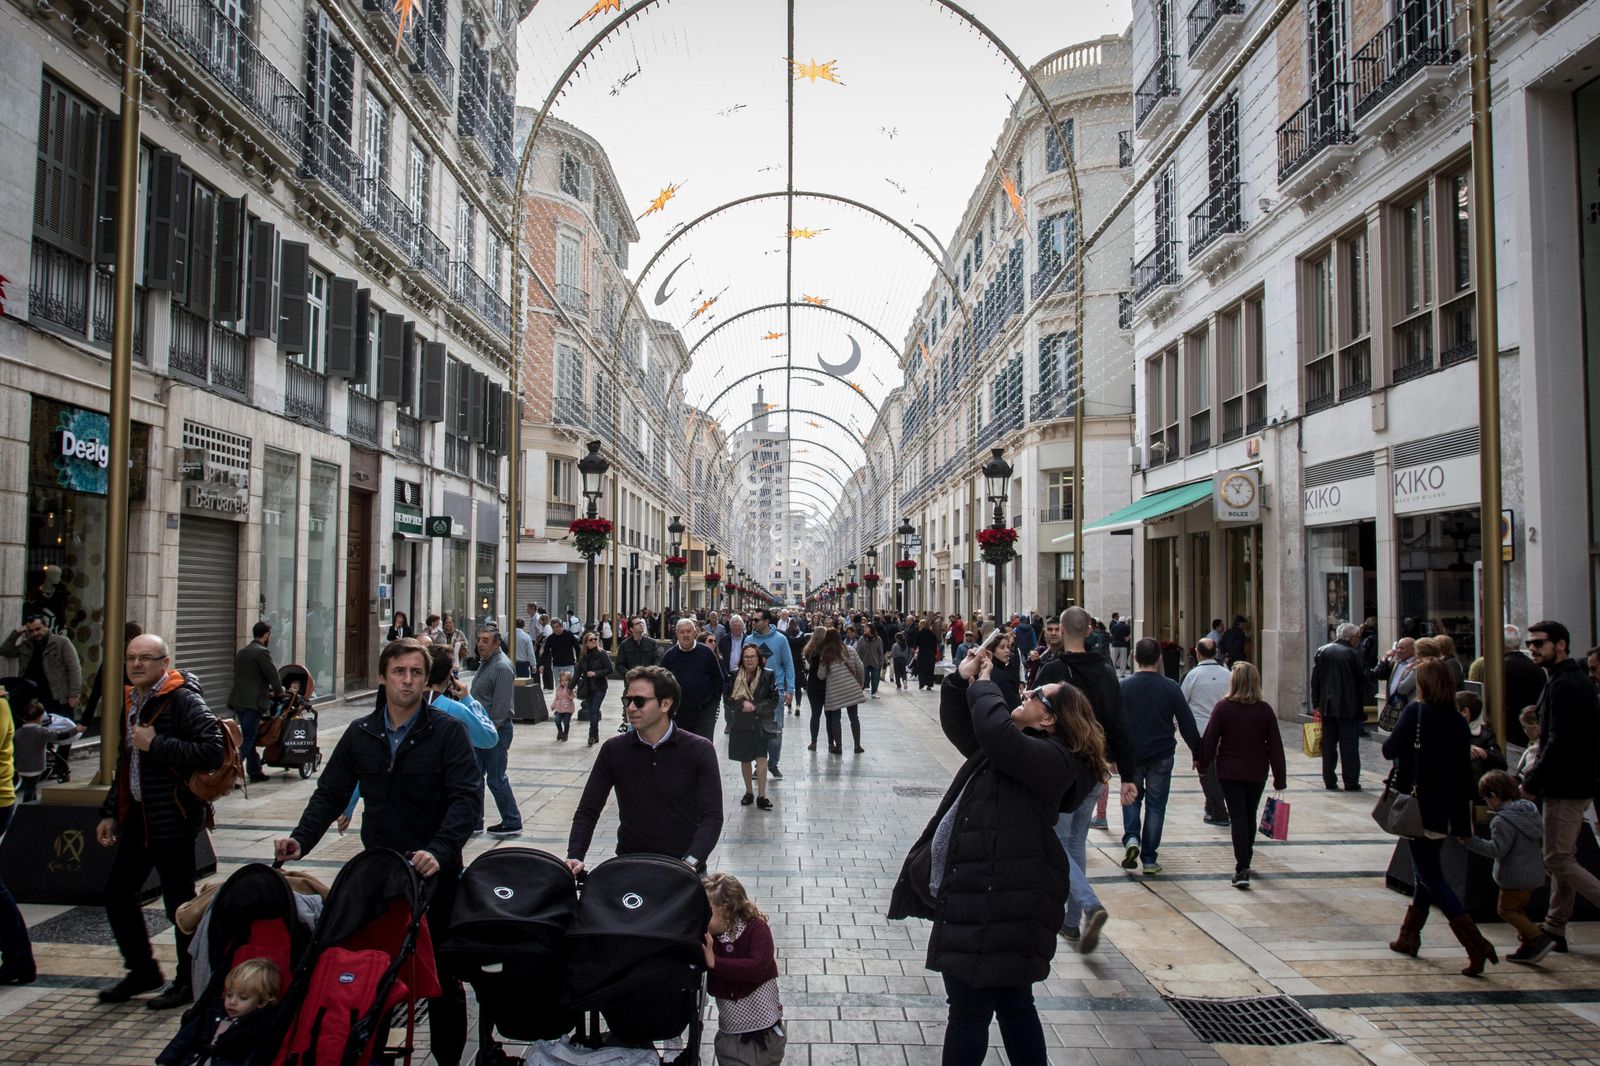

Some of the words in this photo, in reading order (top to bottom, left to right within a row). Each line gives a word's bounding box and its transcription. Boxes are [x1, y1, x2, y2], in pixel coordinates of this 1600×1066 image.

[1395, 465, 1445, 497] KIKO
[1304, 486, 1341, 511] KIKO
[1529, 526, 1537, 544] 2
